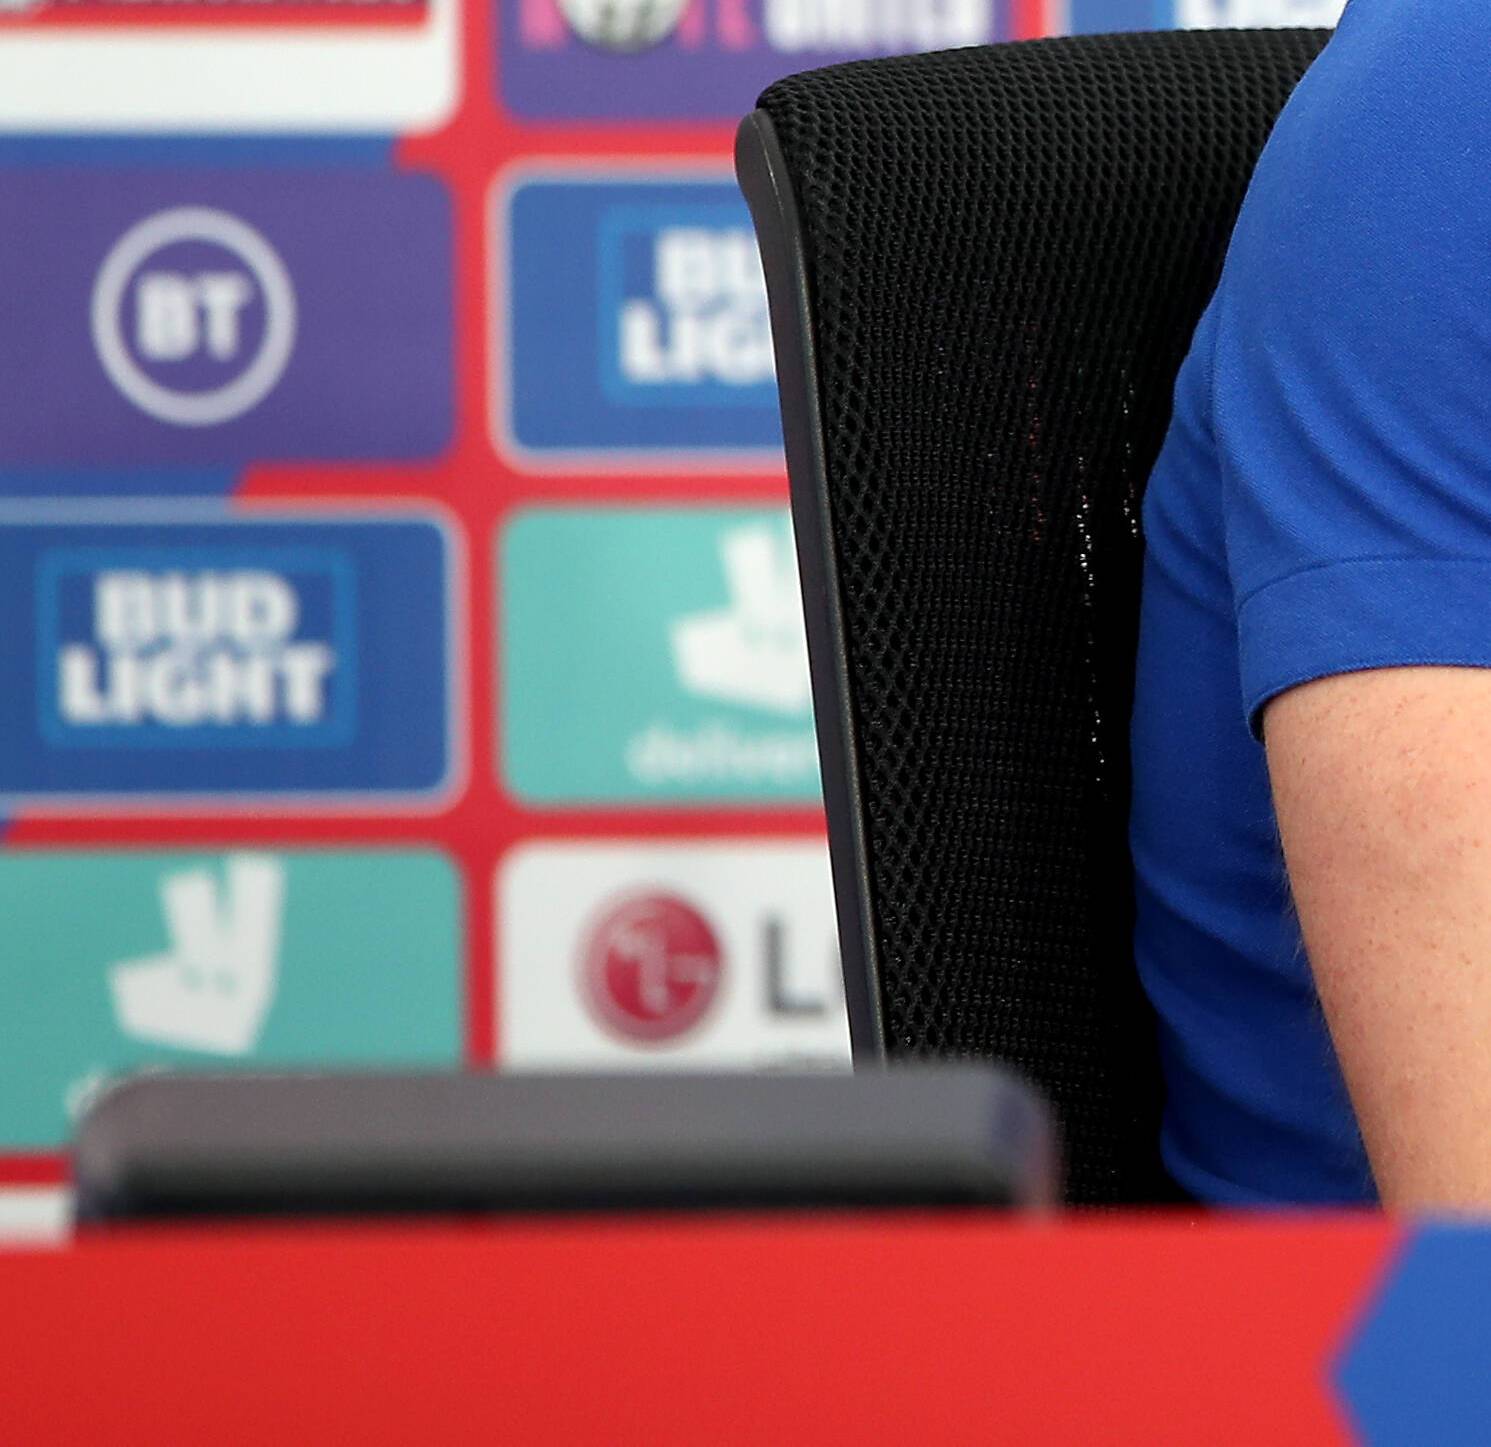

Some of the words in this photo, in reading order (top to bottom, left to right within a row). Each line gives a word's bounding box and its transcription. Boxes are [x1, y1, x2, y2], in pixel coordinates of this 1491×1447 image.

[655, 228, 766, 302] BU
[134, 270, 251, 362] BT
[620, 301, 774, 384] LIG
[92, 568, 300, 641] BUD
[58, 642, 335, 725] LIGHT
